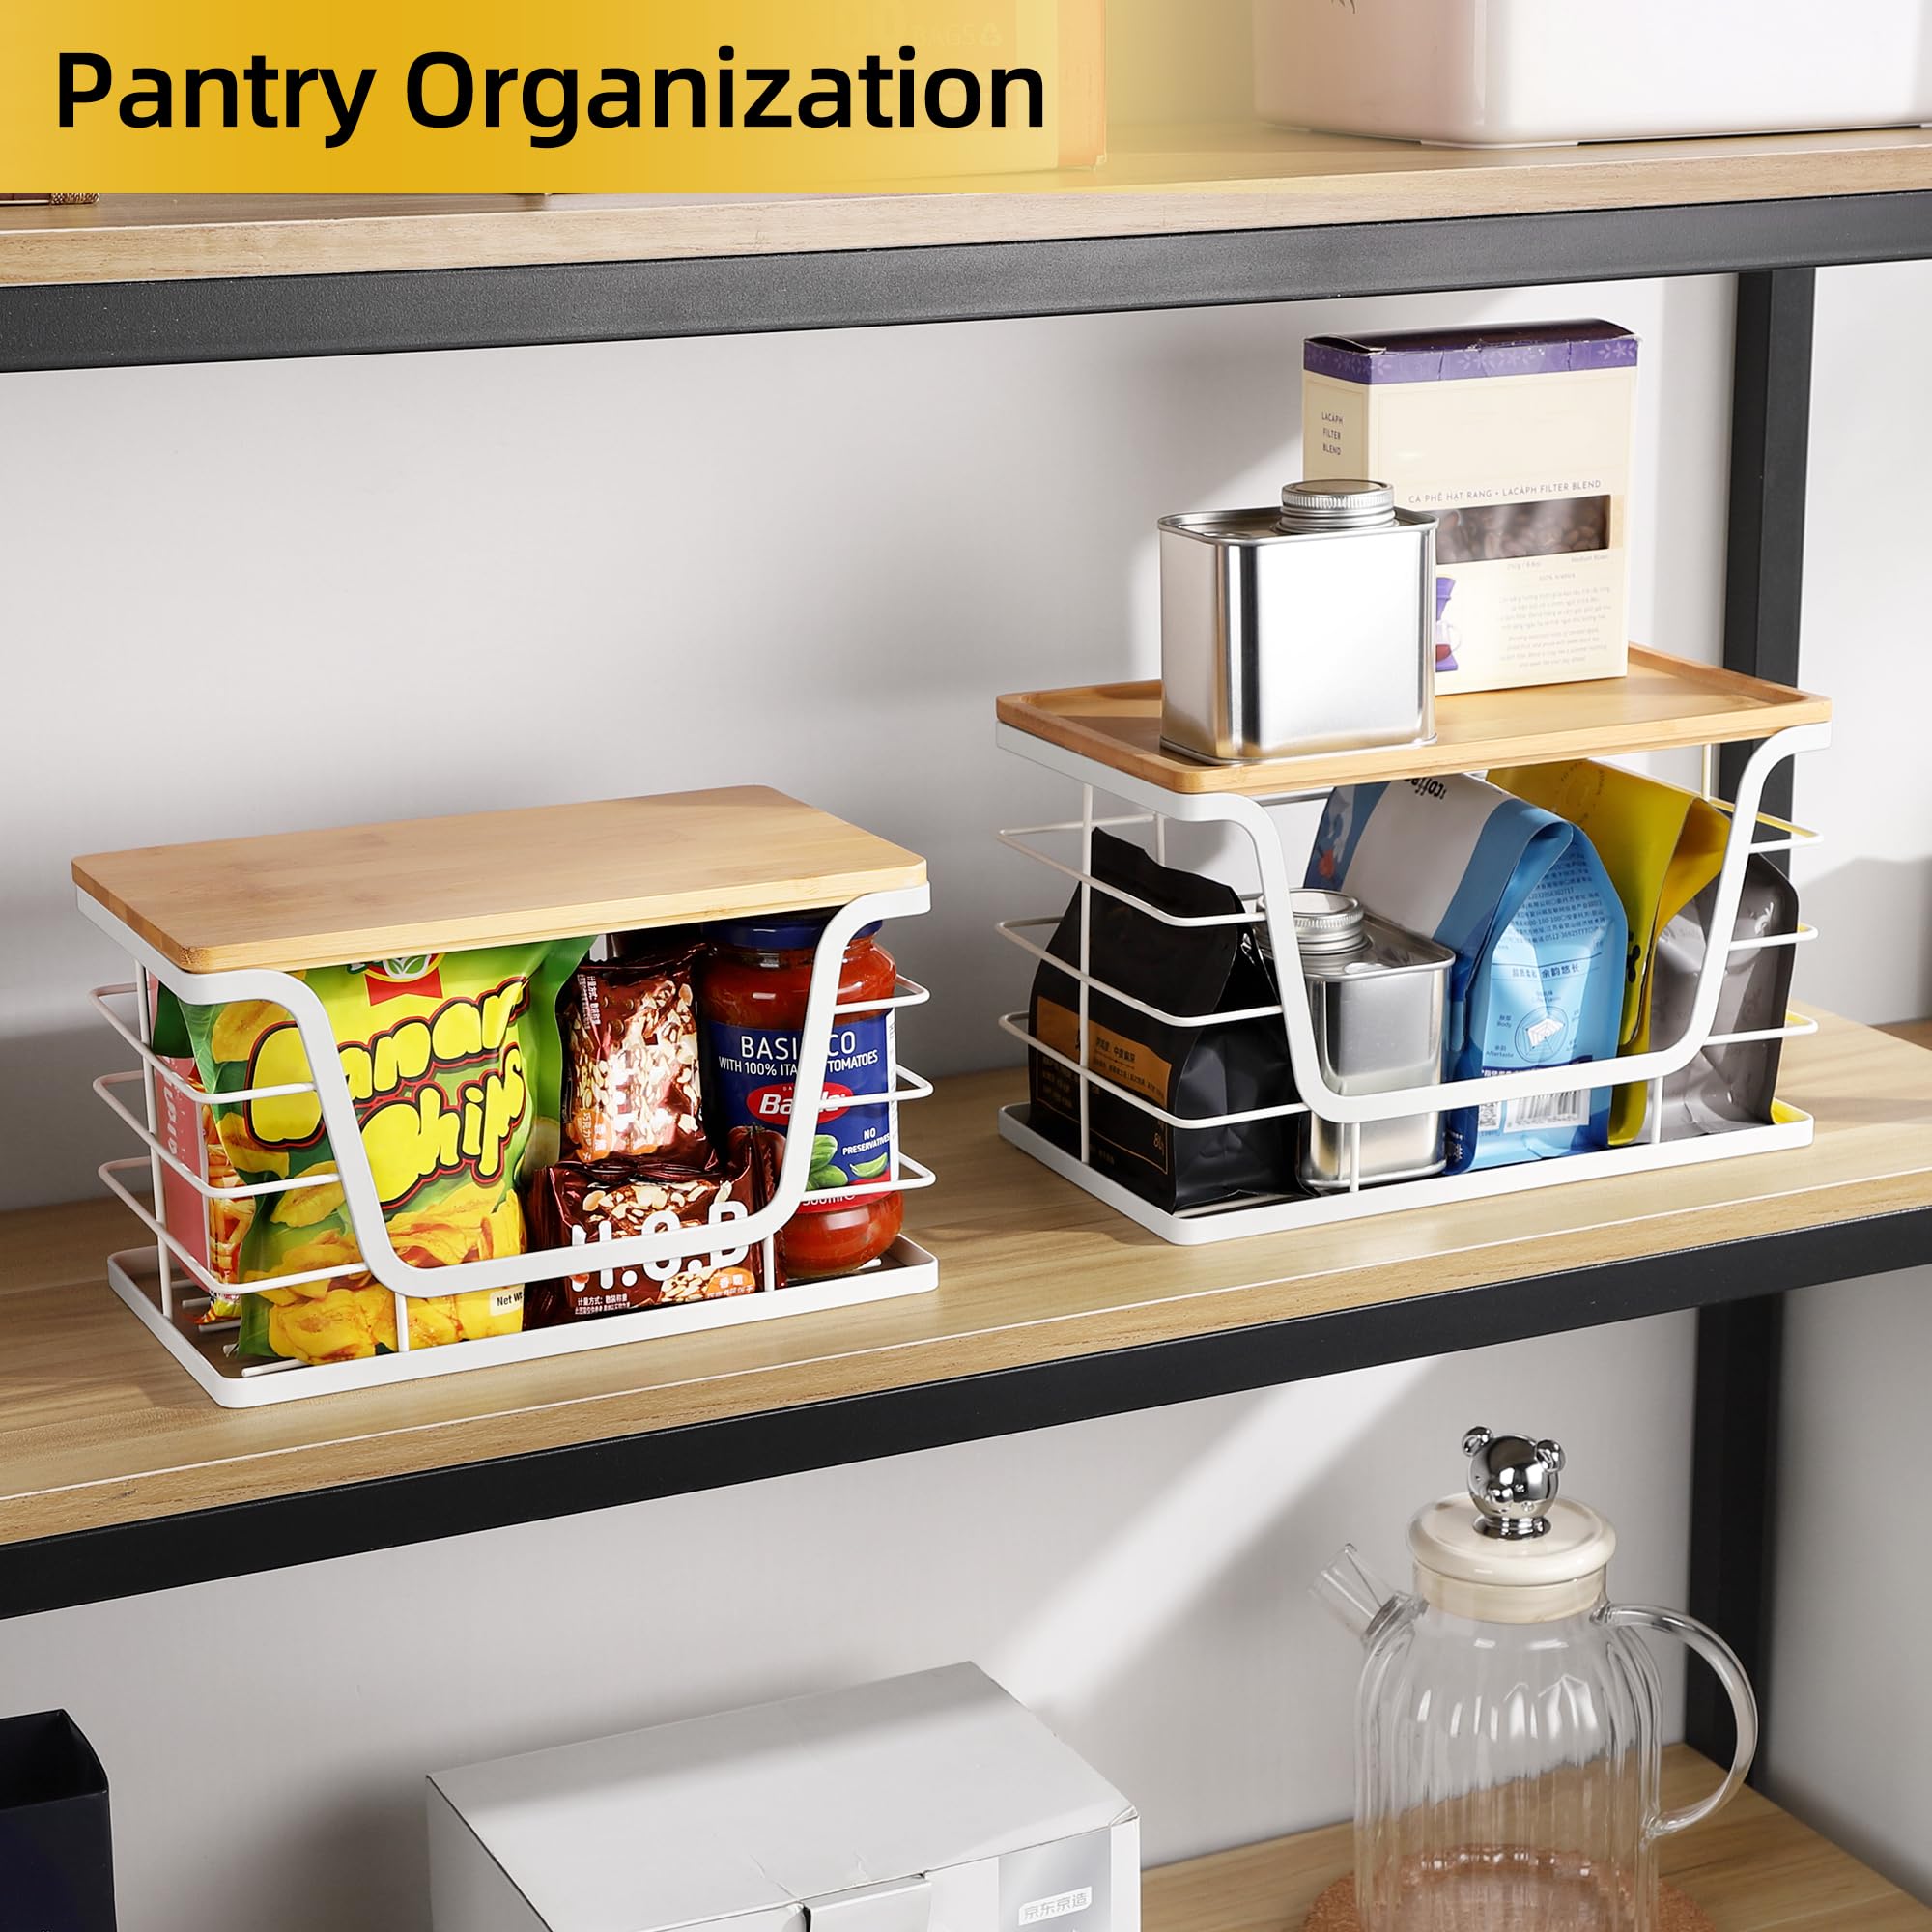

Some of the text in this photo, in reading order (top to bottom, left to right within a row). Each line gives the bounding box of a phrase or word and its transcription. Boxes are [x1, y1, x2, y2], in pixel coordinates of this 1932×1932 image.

[1322, 427, 1341, 440] FILTER
[1322, 442, 1342, 456] BLEND
[1466, 488, 1492, 499] RANG
[1540, 481, 1569, 494] FILTER
[1572, 479, 1602, 491] BLEND
[741, 1031, 856, 1061] BASICO
[719, 1055, 743, 1073] WITH
[745, 1062, 777, 1076] 100%
[828, 1049, 879, 1073] TOMATOES
[863, 1127, 877, 1140] NO
[497, 1294, 512, 1306] Net
[1024, 1892, 1087, 1921] 京东京造
